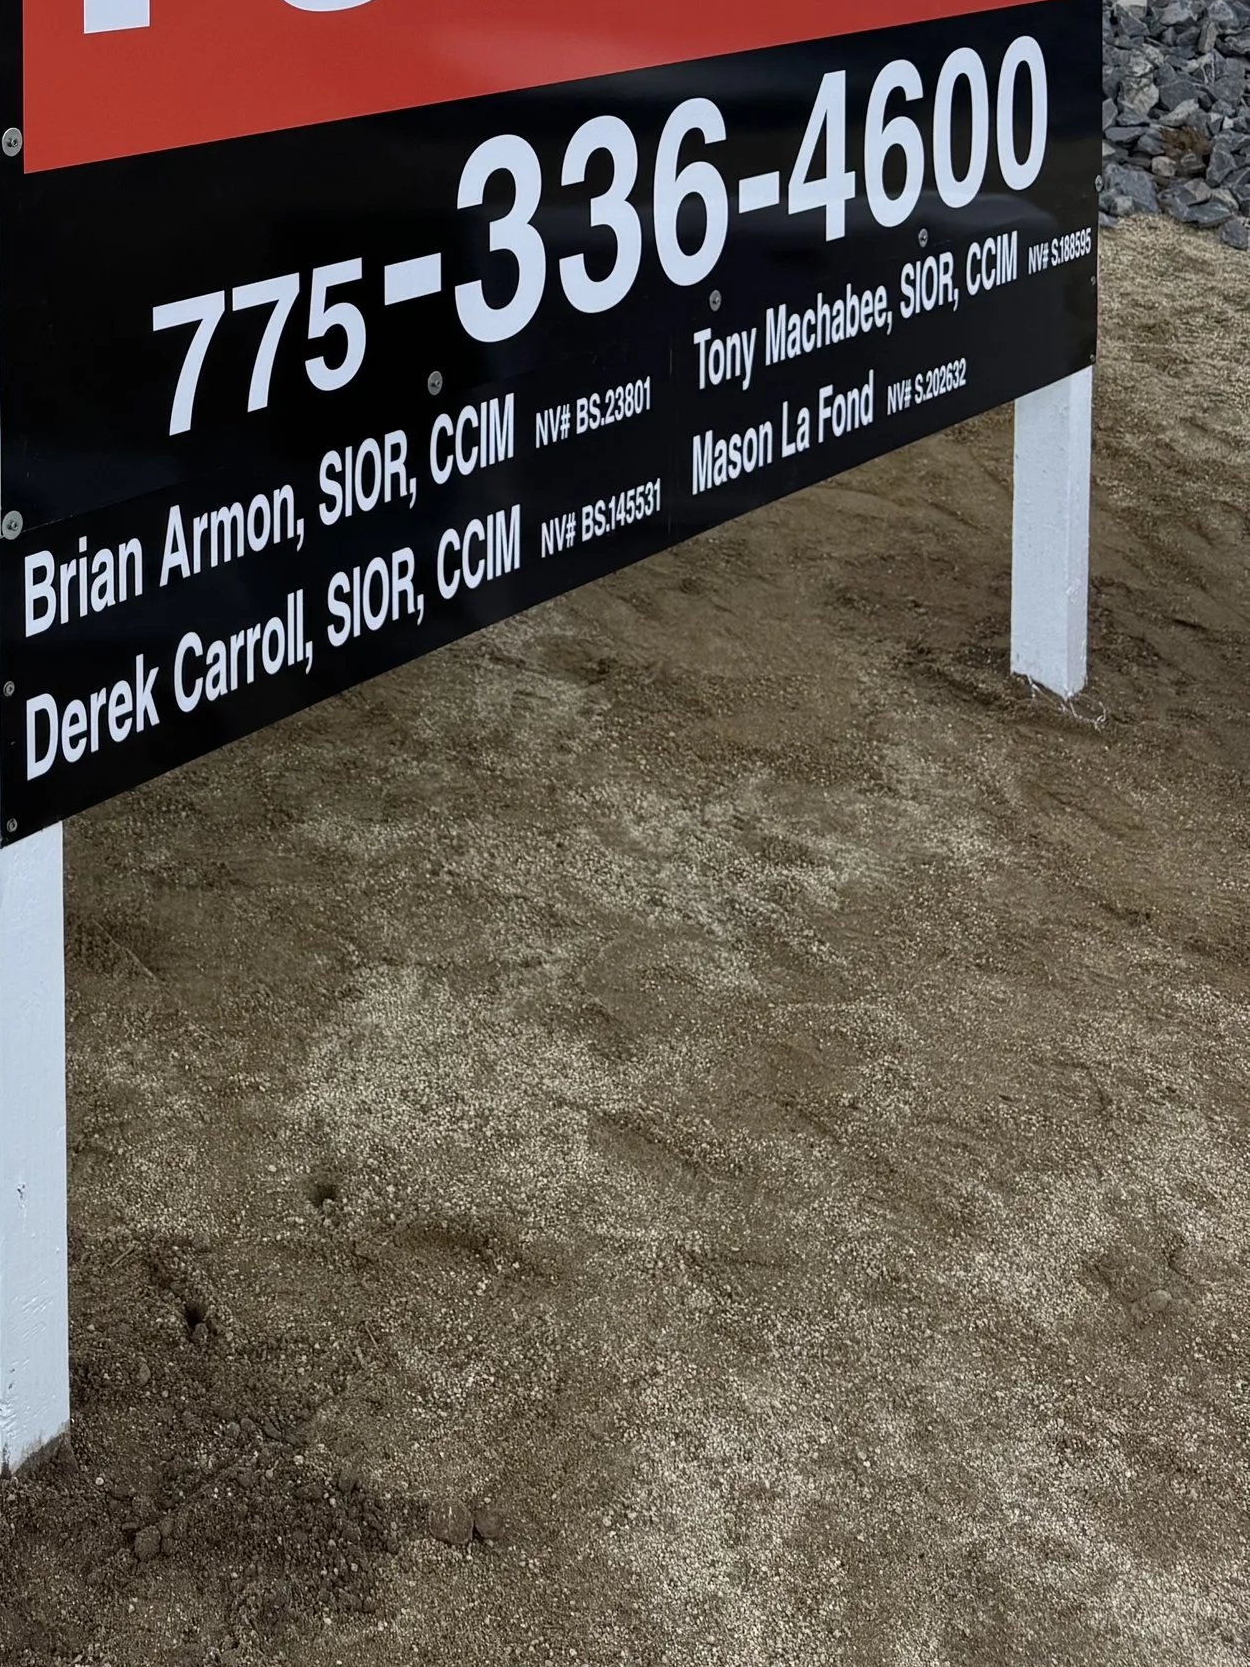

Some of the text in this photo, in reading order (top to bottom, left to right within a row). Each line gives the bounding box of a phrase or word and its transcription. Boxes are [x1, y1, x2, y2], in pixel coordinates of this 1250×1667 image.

[153, 36, 1048, 436] 775-336-4600
[693, 228, 1092, 390] Tony Machabee, SIOR, CCIM NV# S.188595
[25, 376, 651, 637] Brian Armon, SIOR, CCIM NV# BS.23801
[693, 358, 967, 494] Mason La Fond NV# S.202632
[27, 478, 661, 780] Derek Carroll, SIOR, CCIM NV# BS.145531
